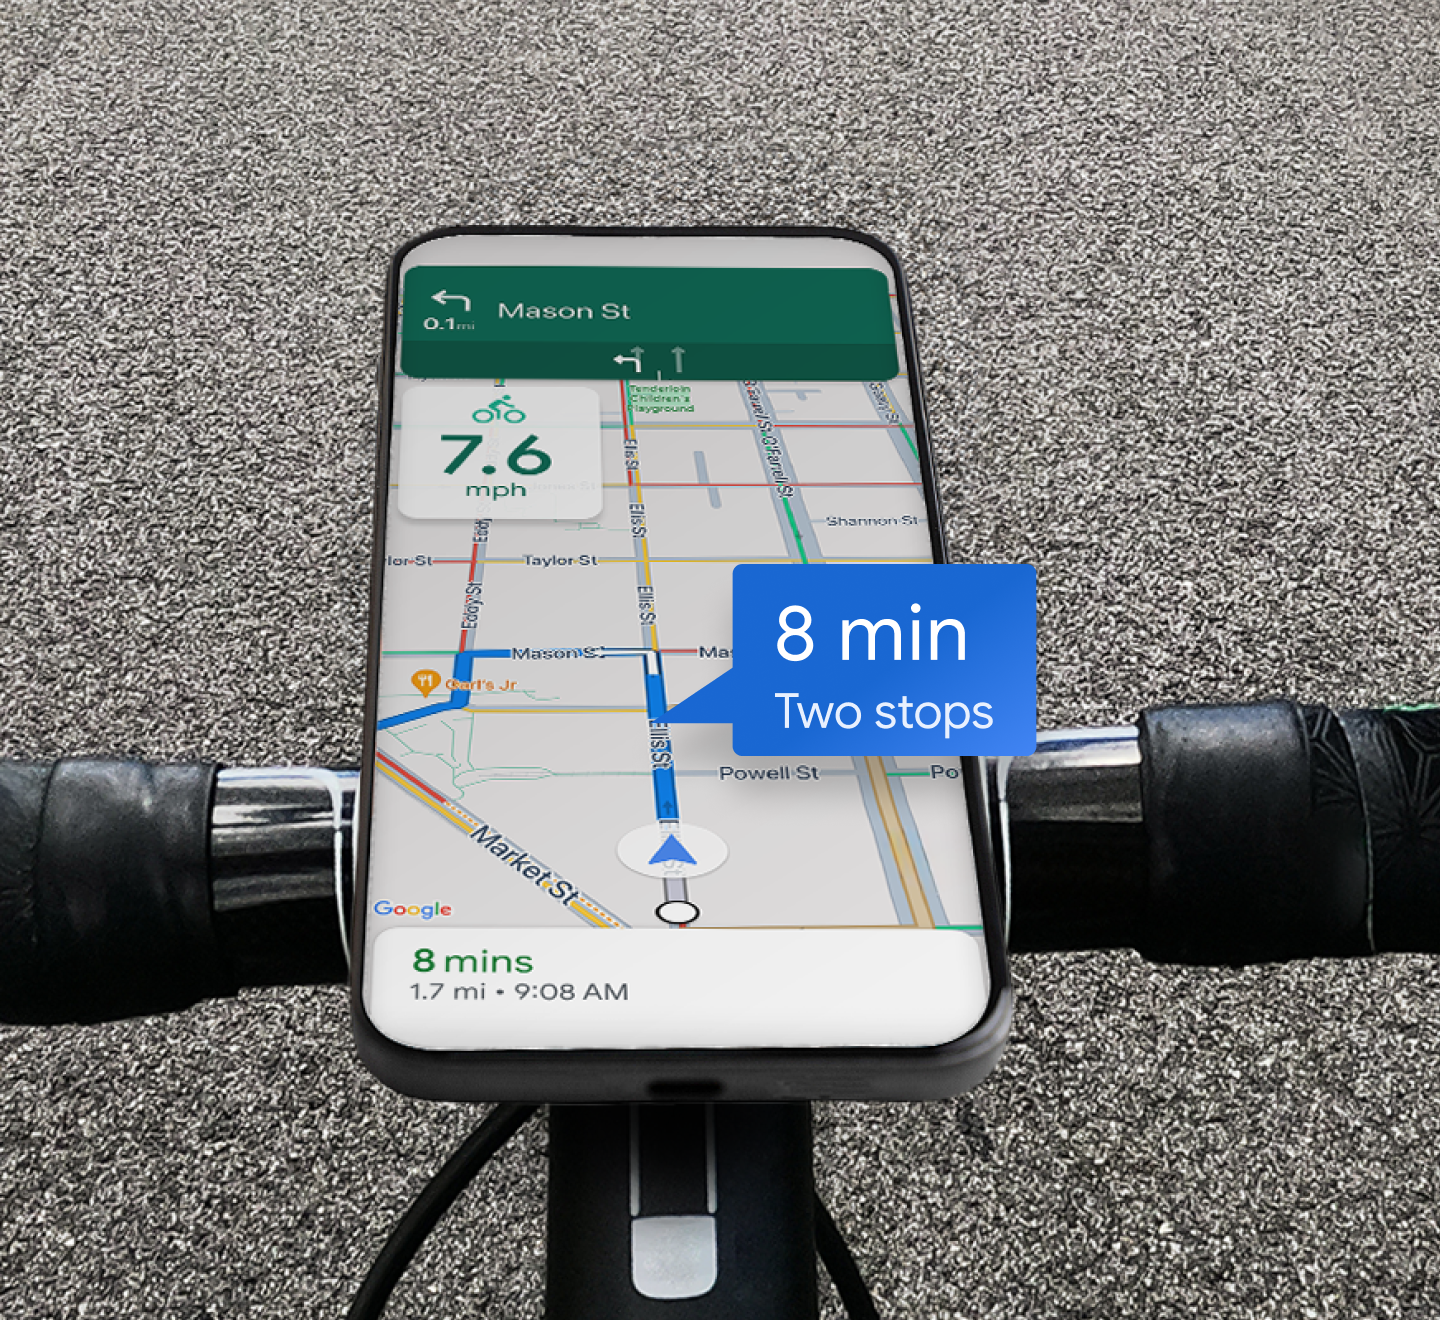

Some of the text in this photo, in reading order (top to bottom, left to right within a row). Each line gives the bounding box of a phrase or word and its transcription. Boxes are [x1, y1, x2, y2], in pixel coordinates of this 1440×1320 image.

[498, 303, 631, 319] Mason St
[441, 434, 552, 475] 7.6
[466, 483, 526, 501] mph
[826, 516, 918, 526] Shannon St
[414, 555, 433, 566] St
[523, 555, 598, 568] Taylor St
[637, 586, 655, 611] Ellis
[461, 598, 484, 629] Eddy
[512, 648, 578, 659] Mason
[498, 679, 517, 691] Jr
[719, 765, 820, 780] Powell St
[470, 825, 579, 906] Market St
[374, 900, 452, 920] Google
[412, 948, 534, 974] 8 mins
[410, 982, 629, 1001] 1.7 mi 9:08 AM
